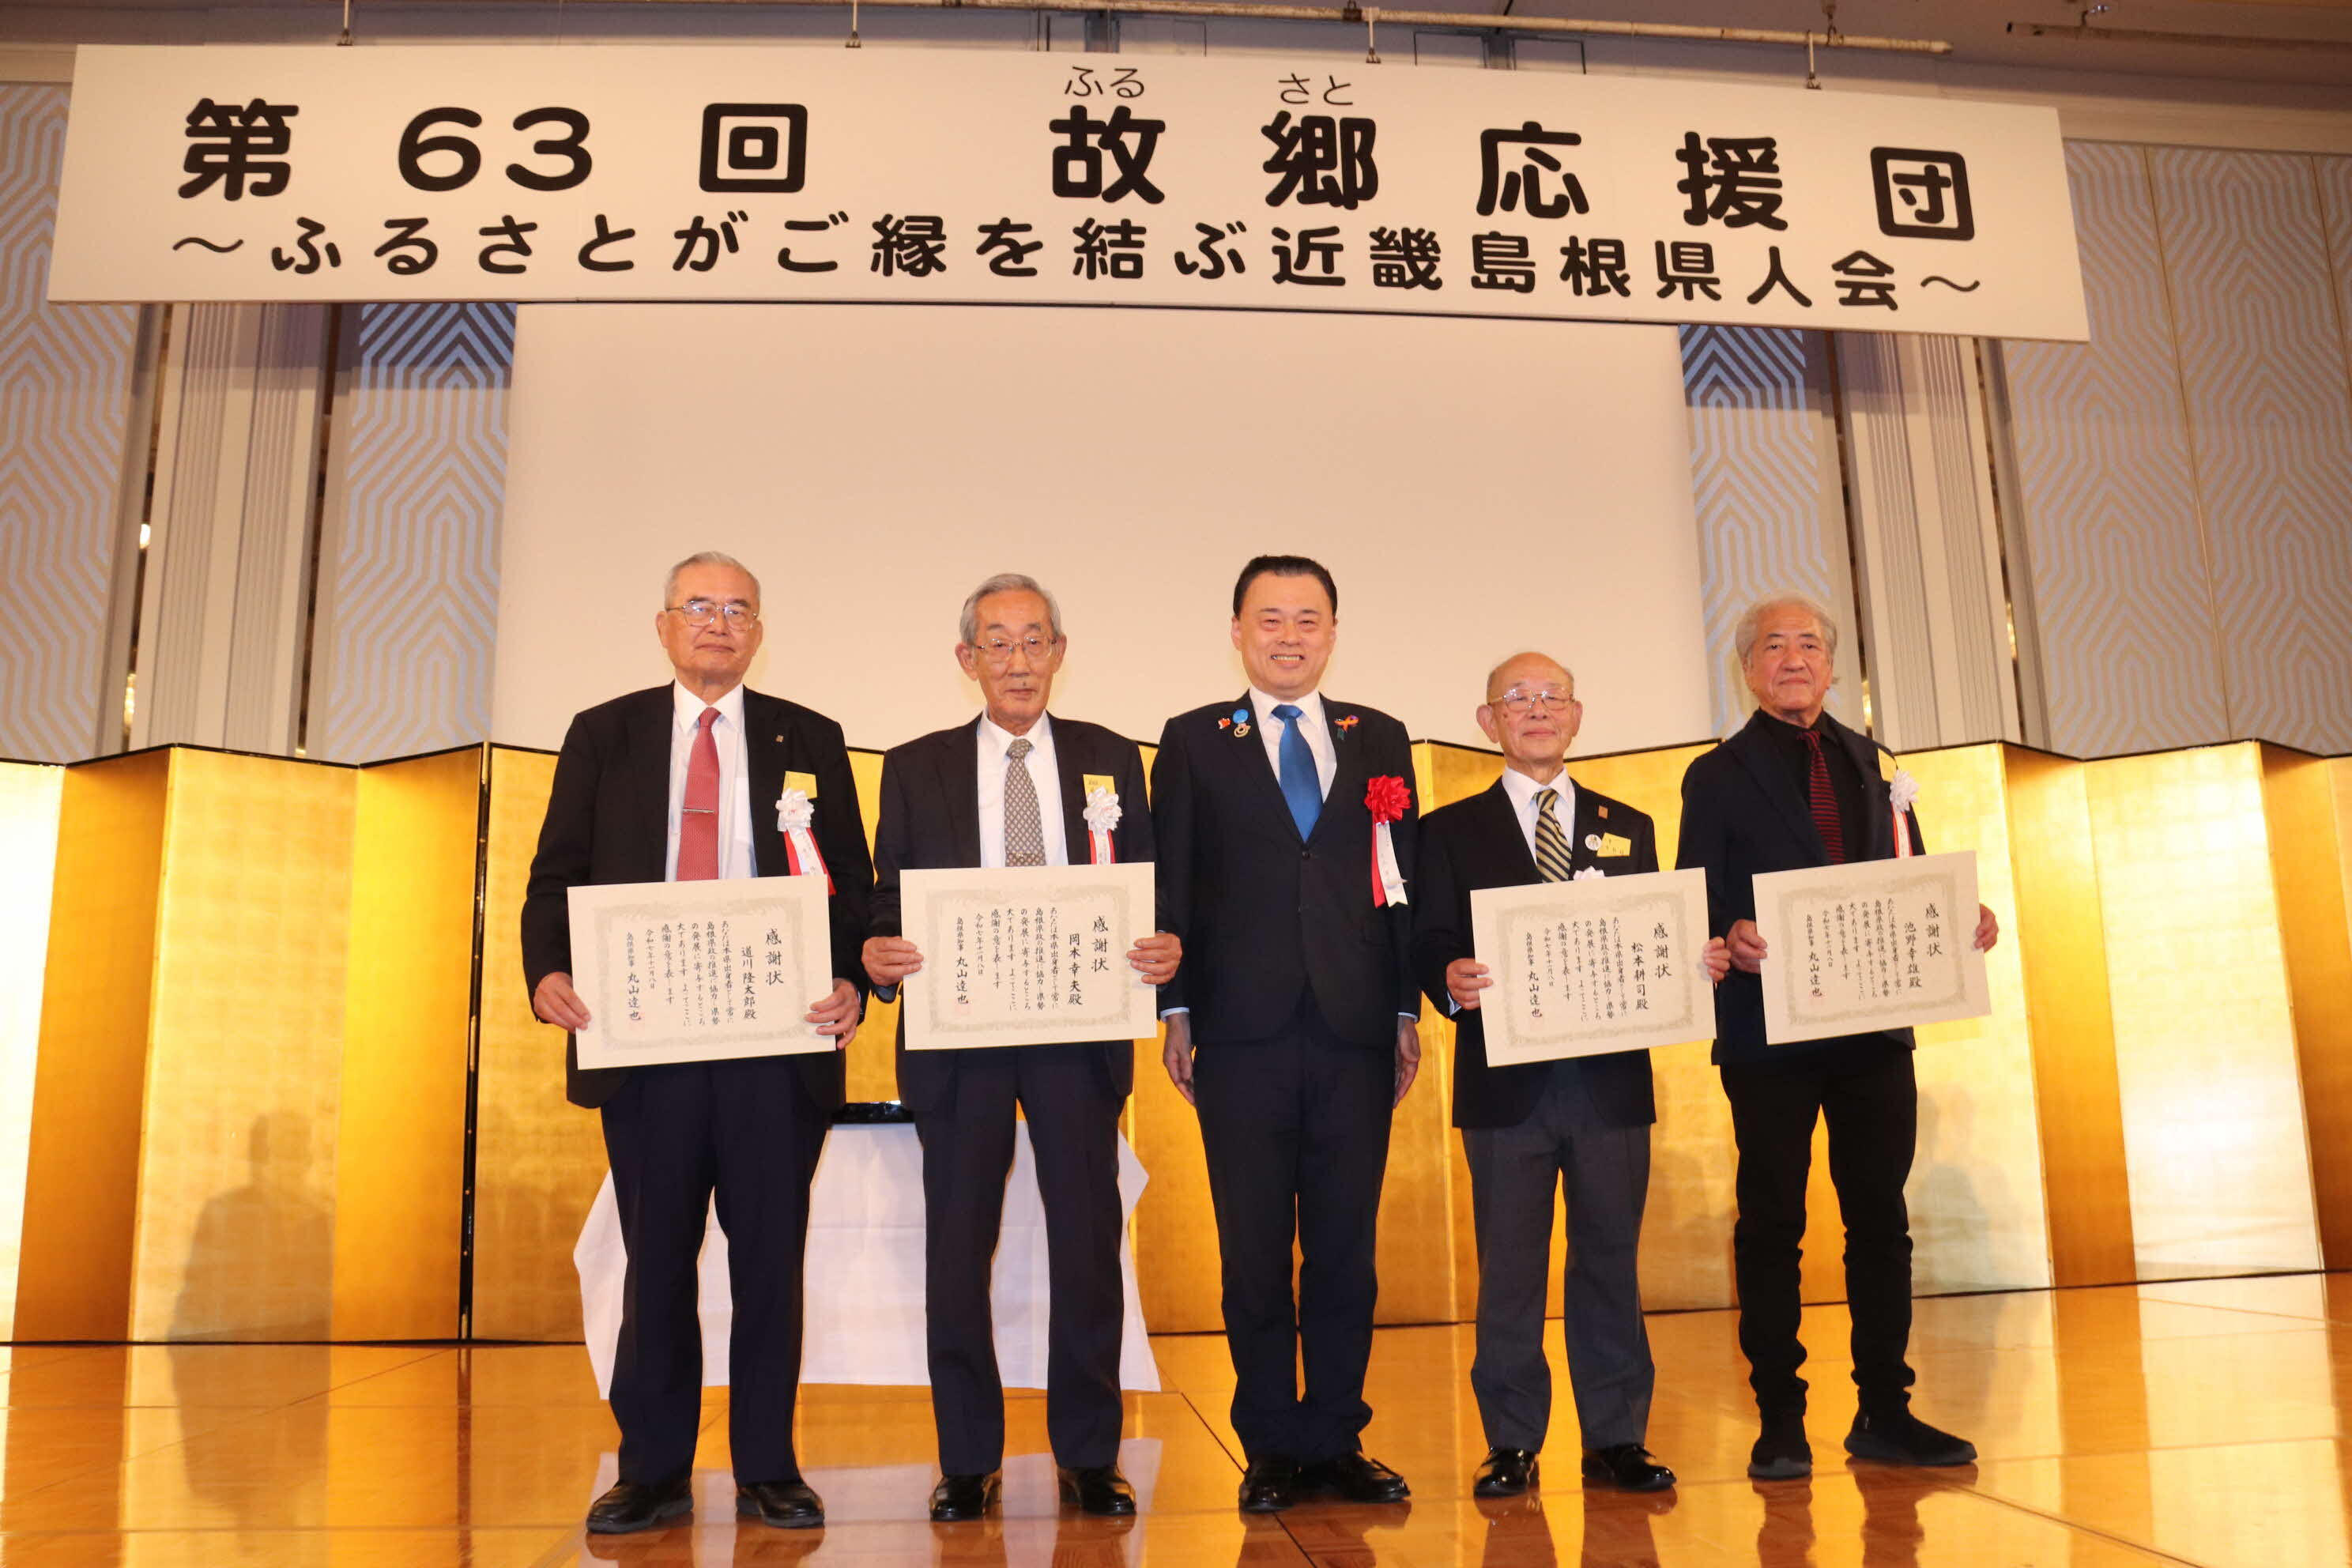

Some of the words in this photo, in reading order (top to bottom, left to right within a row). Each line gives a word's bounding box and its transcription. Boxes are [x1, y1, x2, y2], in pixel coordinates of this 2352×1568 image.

[1063, 66, 1146, 100] ふる
[1277, 71, 1354, 107] さと
[178, 98, 808, 201] 第63回
[1049, 104, 1975, 241] 故郷応援団
[646, 929, 656, 989] 令和七年十一月八日
[765, 929, 783, 986] 感謝状
[975, 913, 984, 974] 令和七年十一月八日
[991, 909, 1001, 989] 感謝の意を表します
[1091, 916, 1109, 972] 感謝状
[1653, 923, 1672, 978] 感謝状
[1904, 922, 1922, 988] 池野幸雄殿
[1925, 903, 1943, 956] 感謝状
[662, 924, 674, 1004] 感謝の意を表します
[741, 945, 756, 1020] 道川隆太郎殿
[956, 956, 969, 1004] 丸山達也
[1068, 933, 1083, 1005] 岡本幸夫殿
[1558, 922, 1572, 1001] 感謝の意を表します
[1631, 942, 1649, 1010] 松本耕司殿
[1808, 952, 1822, 997] 丸山達也
[628, 972, 641, 1020] 丸山達也
[1528, 971, 1543, 1018] 丸山達也
